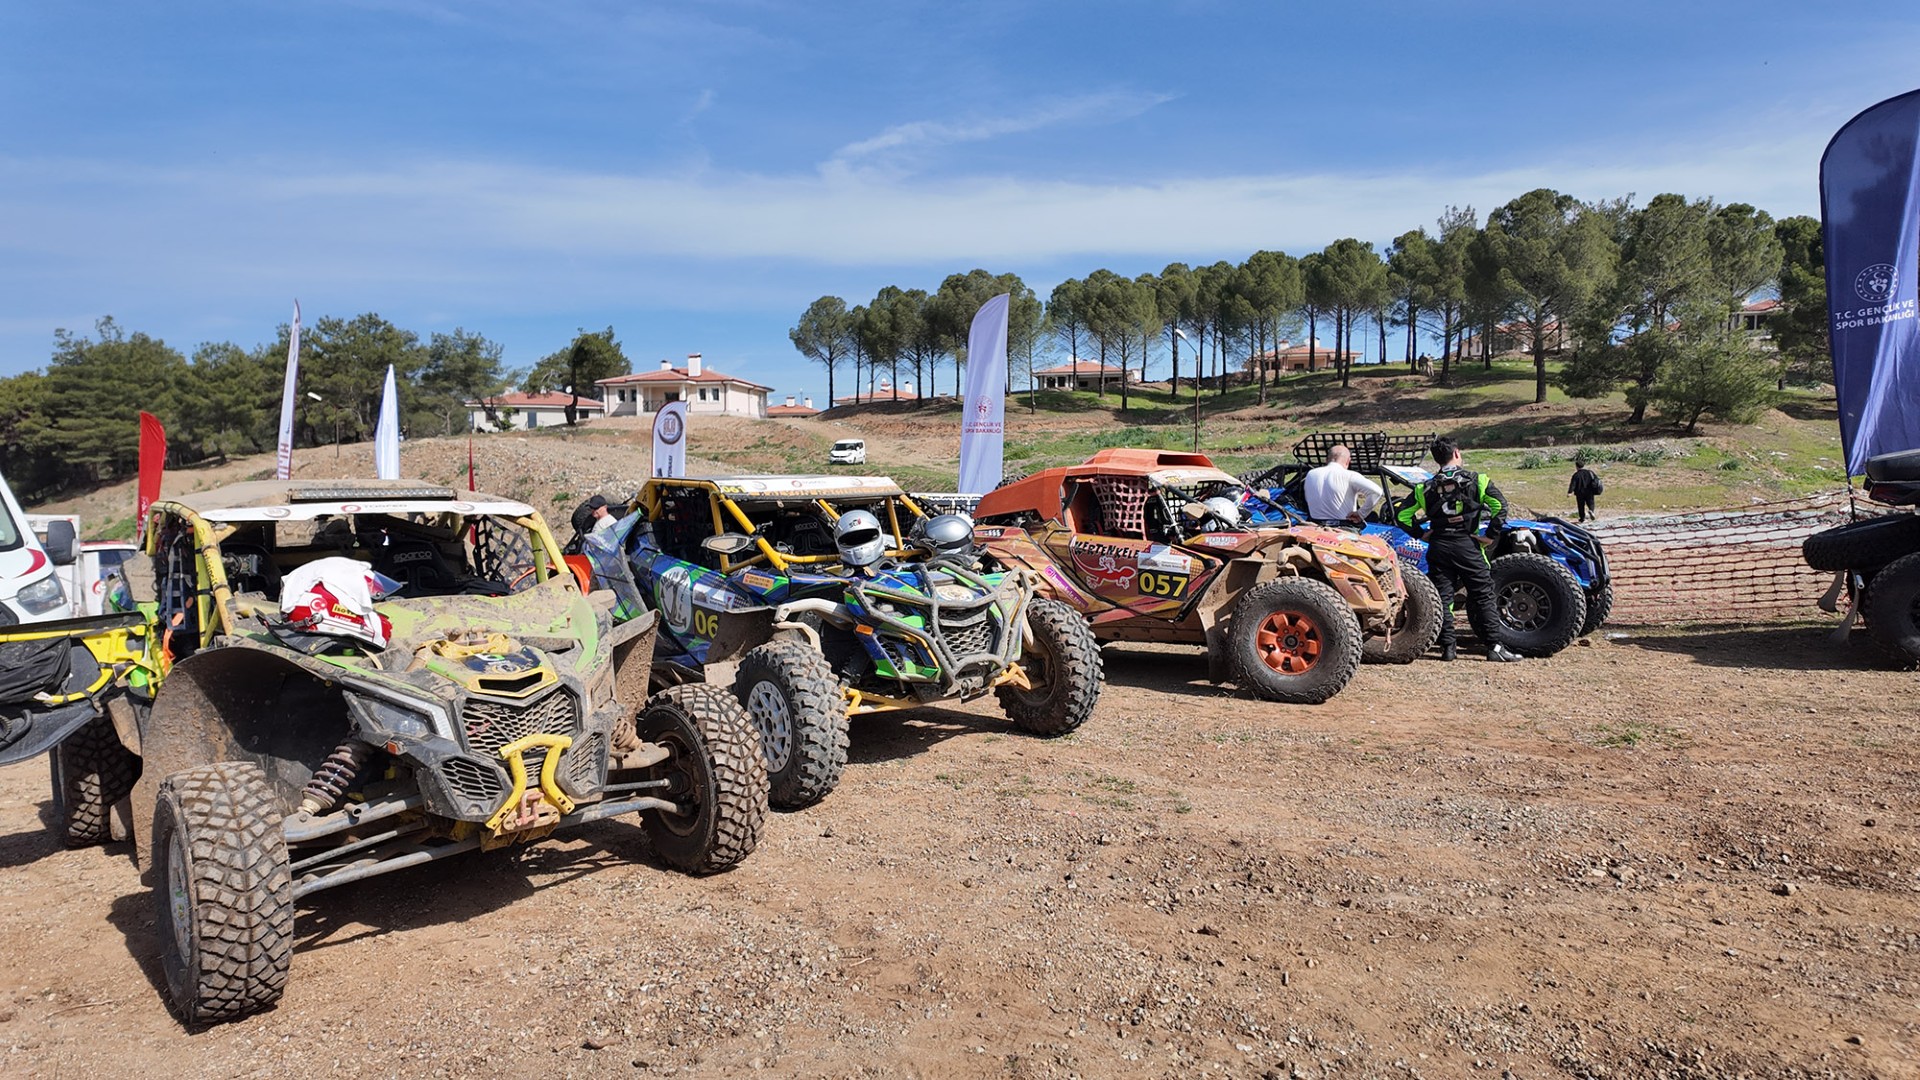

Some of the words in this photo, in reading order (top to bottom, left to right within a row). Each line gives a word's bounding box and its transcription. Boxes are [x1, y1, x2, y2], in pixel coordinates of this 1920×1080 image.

[1835, 310, 1856, 320] T.C.
[1902, 299, 1915, 309] VE
[1836, 319, 1864, 331] SPOR
[393, 550, 432, 563] sparco
[1139, 572, 1188, 597] 057
